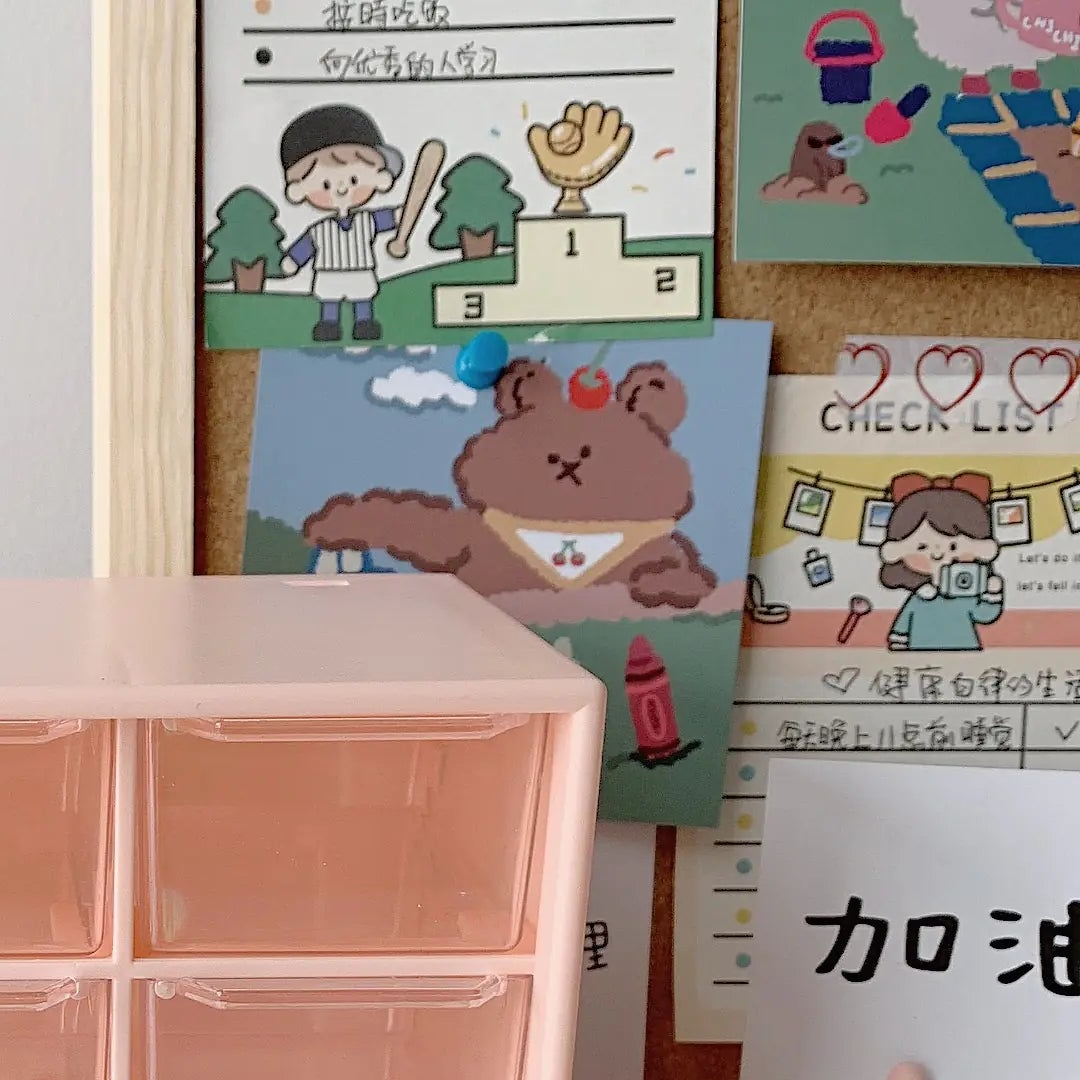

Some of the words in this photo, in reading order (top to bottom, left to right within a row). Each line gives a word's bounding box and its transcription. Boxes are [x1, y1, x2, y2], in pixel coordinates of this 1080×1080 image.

[565, 228, 579, 256] 1
[655, 266, 676, 292] 2
[464, 291, 484, 319] 3
[821, 401, 950, 432] CHECK
[972, 400, 1063, 432] LIST
[805, 895, 1080, 997] 加油
